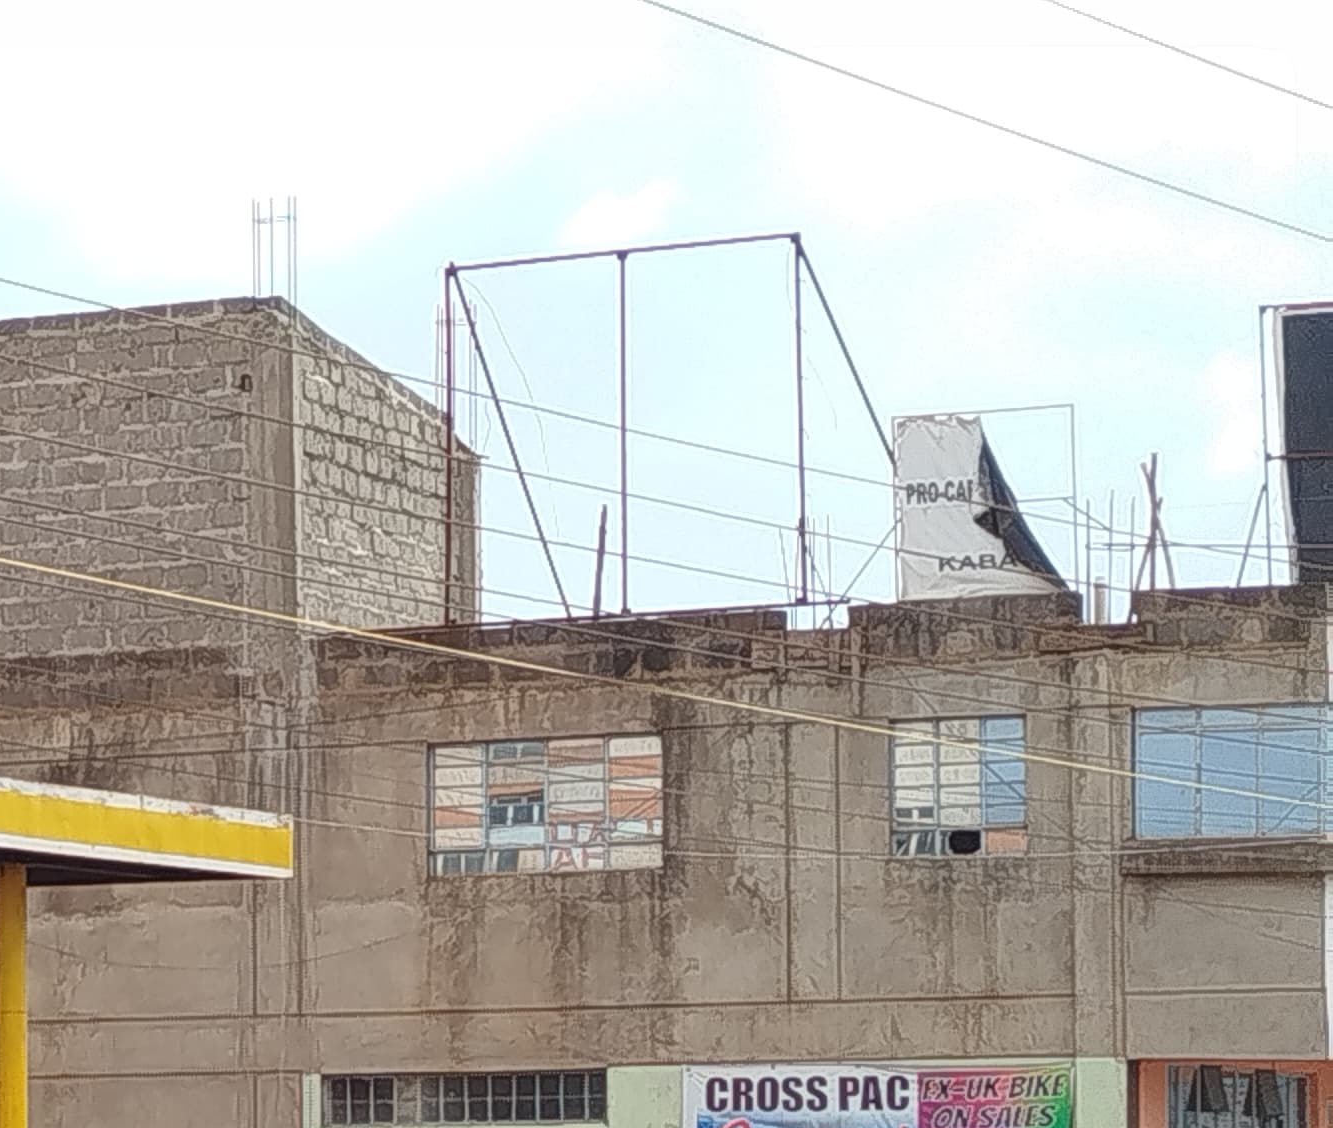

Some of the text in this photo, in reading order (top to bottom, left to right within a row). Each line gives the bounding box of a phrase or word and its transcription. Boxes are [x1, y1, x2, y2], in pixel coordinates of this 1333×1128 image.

[706, 1076, 910, 1111] CROSS PAC
[1007, 1074, 1070, 1098] BIKE
